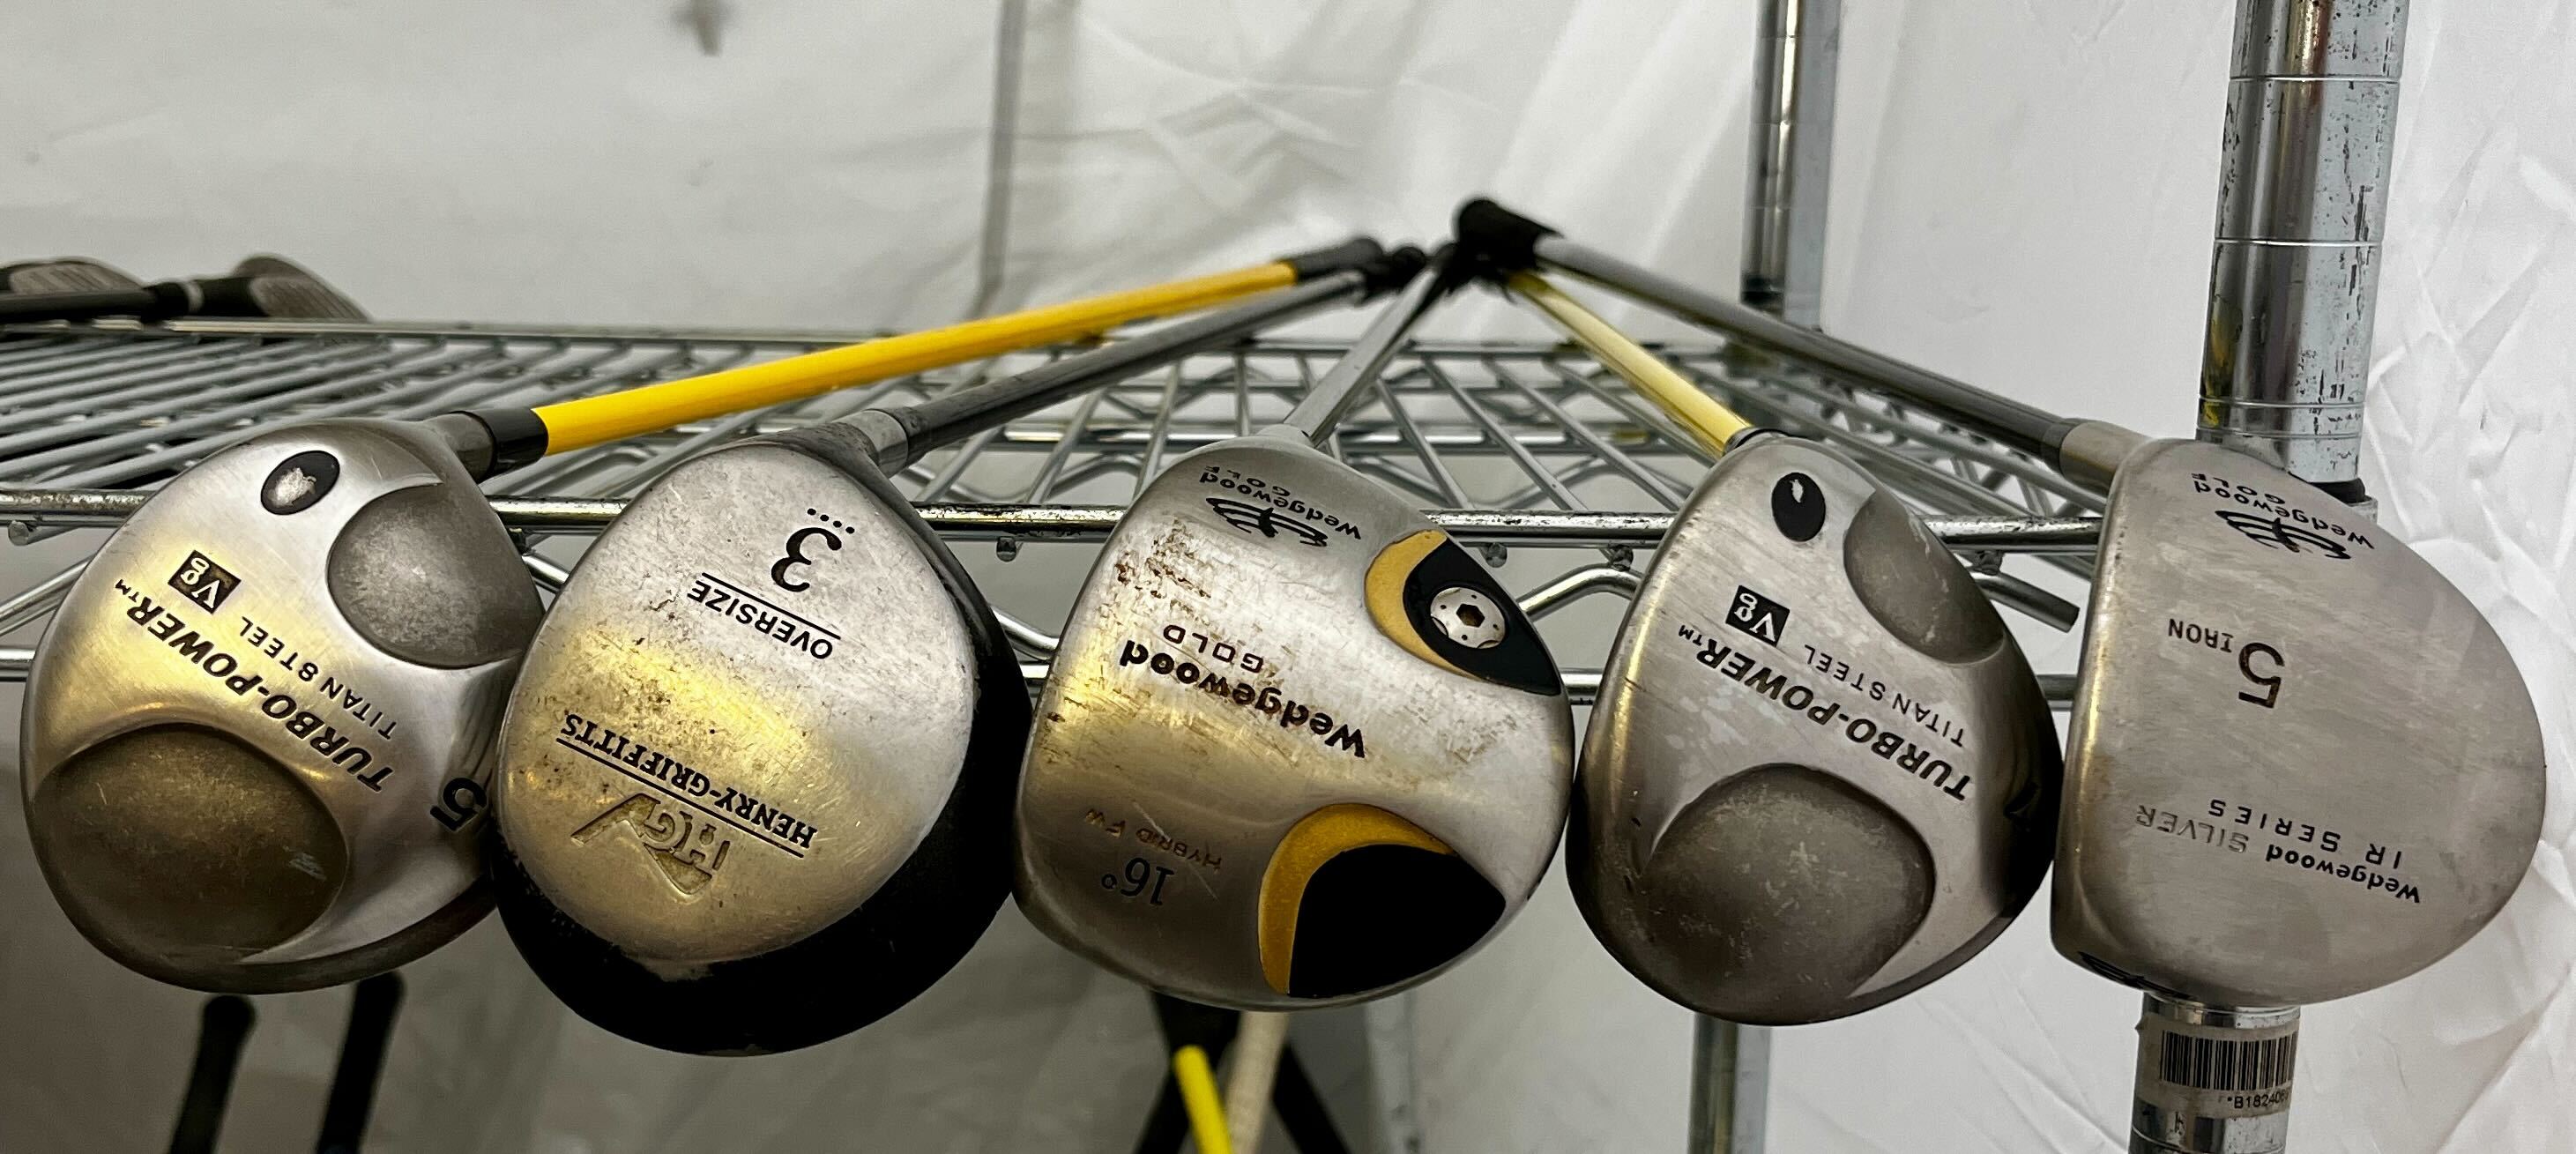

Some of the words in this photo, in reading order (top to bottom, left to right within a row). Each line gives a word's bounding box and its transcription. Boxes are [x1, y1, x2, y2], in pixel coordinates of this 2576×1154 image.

[1199, 472, 1362, 540] Wedgewood
[1204, 465, 1291, 497] GOLF
[2191, 473, 2286, 504] GOLF
[2193, 480, 2375, 549] Wedgewood
[771, 526, 843, 592] 3
[687, 580, 833, 659] OVERSIZE
[2168, 618, 2234, 653] IRON
[1162, 624, 1265, 674] GOLD
[1805, 644, 1887, 702] STEEL
[2237, 642, 2286, 709] 5
[1119, 640, 1366, 758] Wedgewood
[1892, 693, 1964, 748] TITAN
[429, 777, 488, 831] 5
[560, 713, 818, 849] HENRY-GRIFFITTS
[2135, 805, 2250, 853] SILVER
[2207, 799, 2341, 852] SERIES
[2265, 844, 2421, 904] Wedgewood
[2364, 843, 2403, 870] IR
